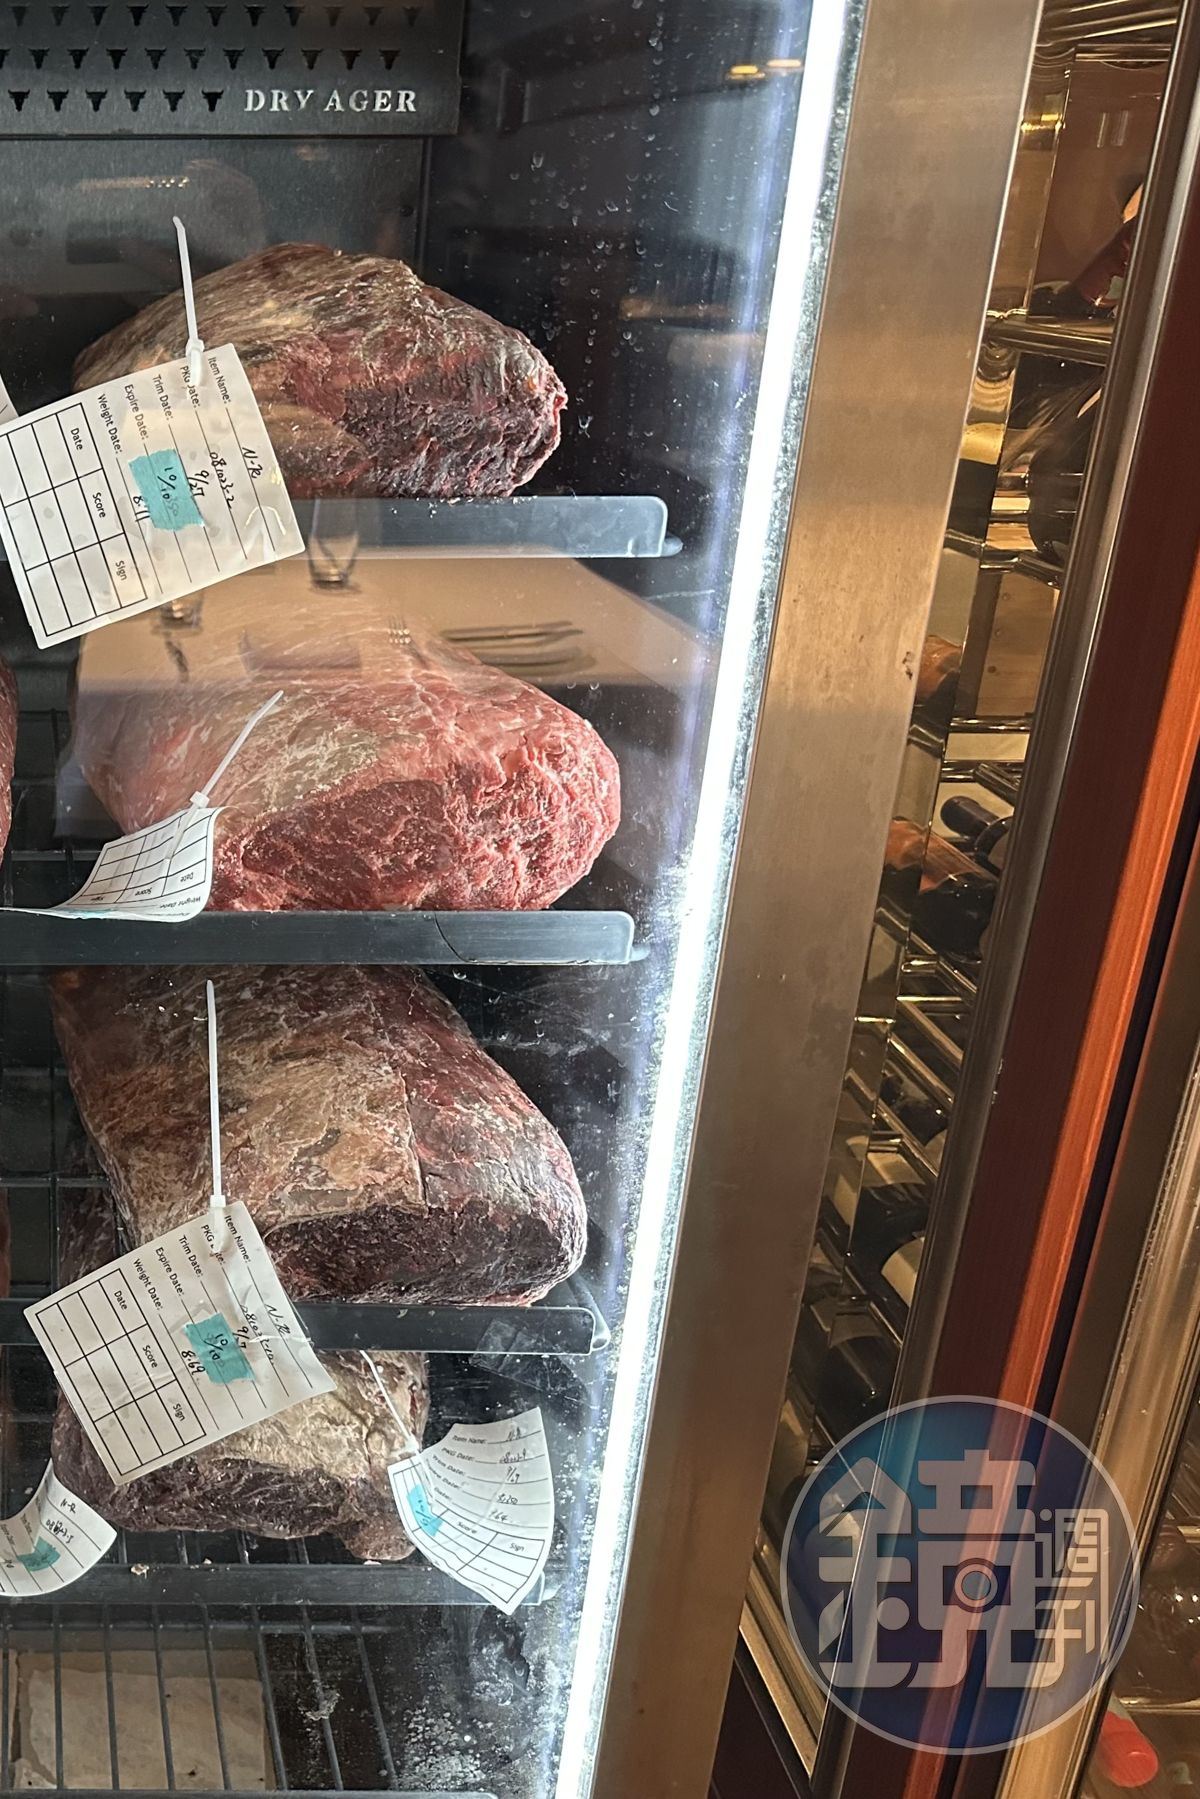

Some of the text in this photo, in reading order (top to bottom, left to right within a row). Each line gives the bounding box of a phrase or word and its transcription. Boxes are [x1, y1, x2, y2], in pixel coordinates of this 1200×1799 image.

[244, 89, 417, 112] DRY AGER
[151, 375, 174, 419] Trim Date:
[208, 357, 231, 403] Item Name:
[94, 395, 123, 453] Weight Date:
[122, 384, 150, 439] Expire Date:
[70, 428, 128, 580] Date Score Sign
[134, 887, 152, 897] Score
[179, 873, 193, 882] Date
[200, 1224, 213, 1241] PKG
[223, 1215, 252, 1262] Item Name:
[154, 1248, 184, 1296] Expire Date:
[178, 1236, 204, 1277] Trim Date:
[131, 1259, 163, 1309] Weight Date:
[114, 1291, 186, 1421] Date Score Sign
[457, 1521, 525, 1552] Score Sign
